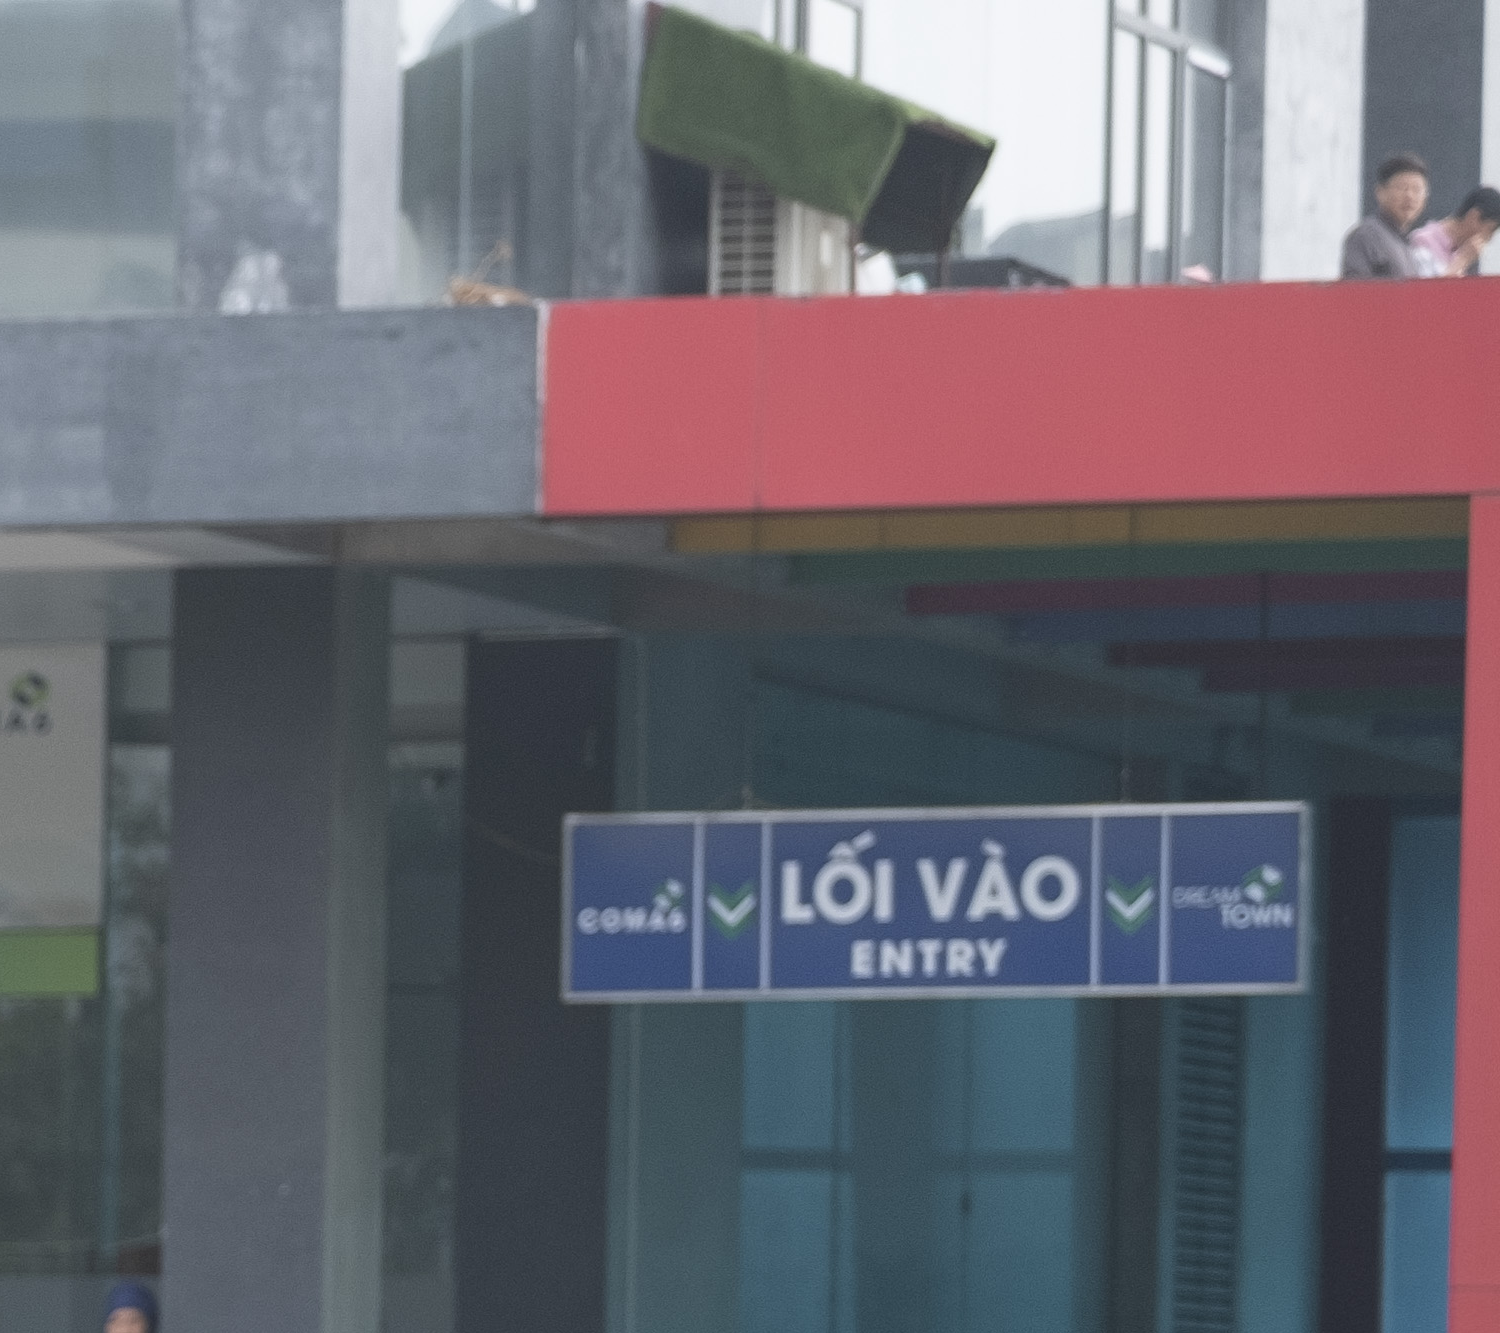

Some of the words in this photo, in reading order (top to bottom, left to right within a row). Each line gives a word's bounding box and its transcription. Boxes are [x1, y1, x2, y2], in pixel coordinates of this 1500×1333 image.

[781, 830, 894, 925] LỐI
[916, 838, 1081, 923] VÀO
[1221, 901, 1294, 930] TOWN
[850, 938, 1008, 978] ENTRY
